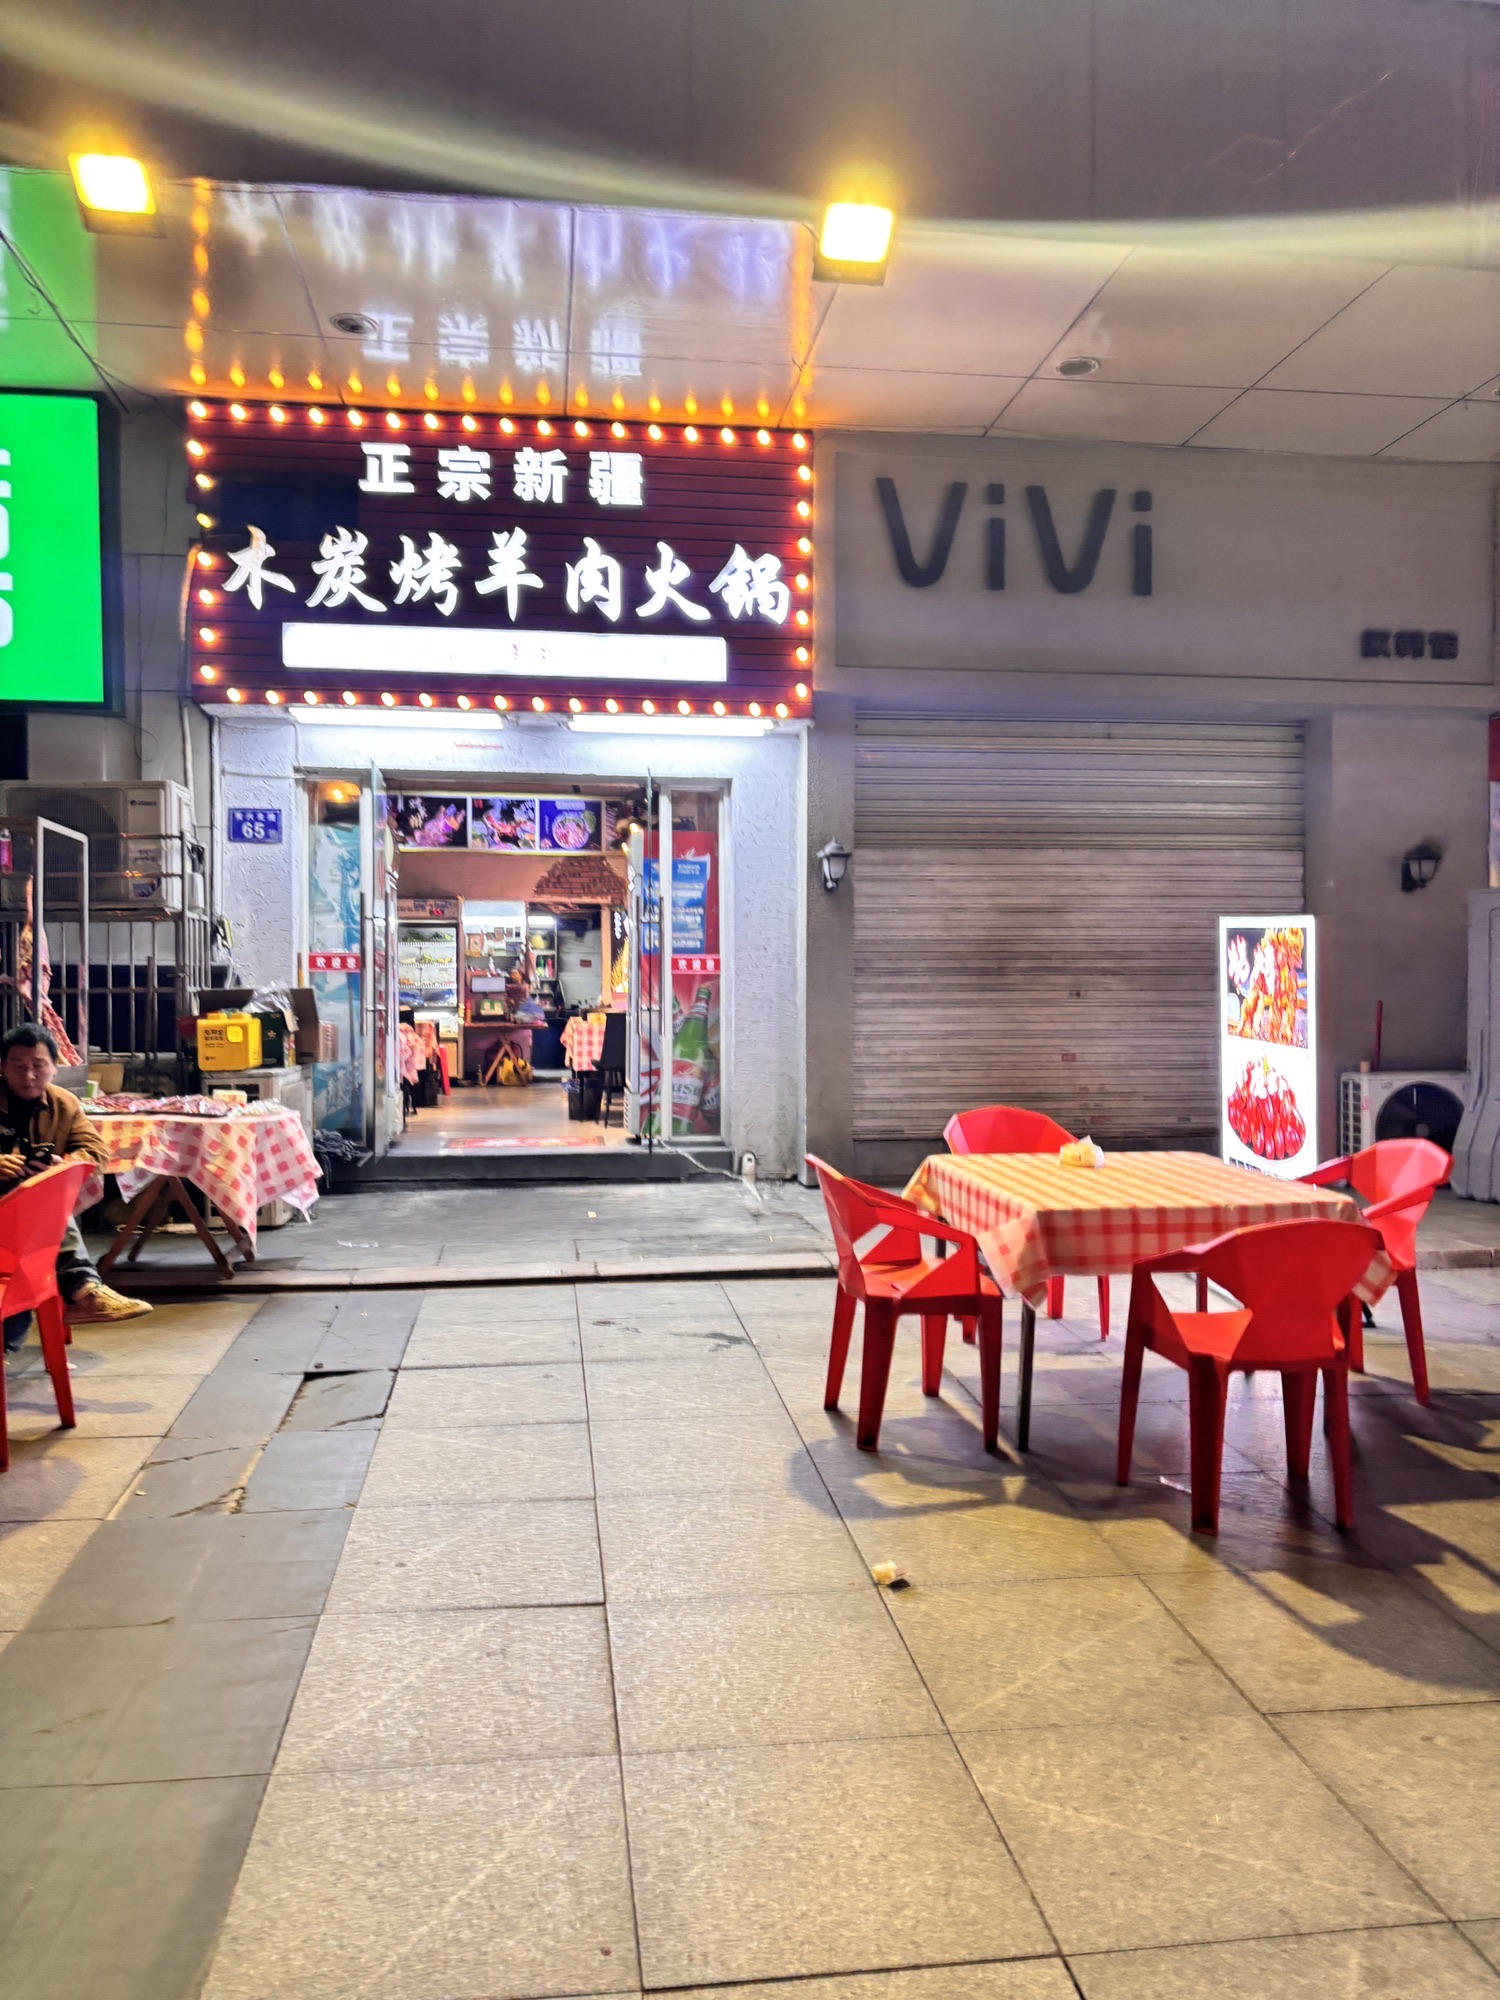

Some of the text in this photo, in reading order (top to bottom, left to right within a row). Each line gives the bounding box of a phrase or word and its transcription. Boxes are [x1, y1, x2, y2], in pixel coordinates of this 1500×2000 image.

[358, 441, 643, 506] 正宗新疆
[222, 524, 791, 625] 木炭烤羊肉火锅
[875, 477, 1153, 596] ViVi
[242, 821, 265, 839] 65
